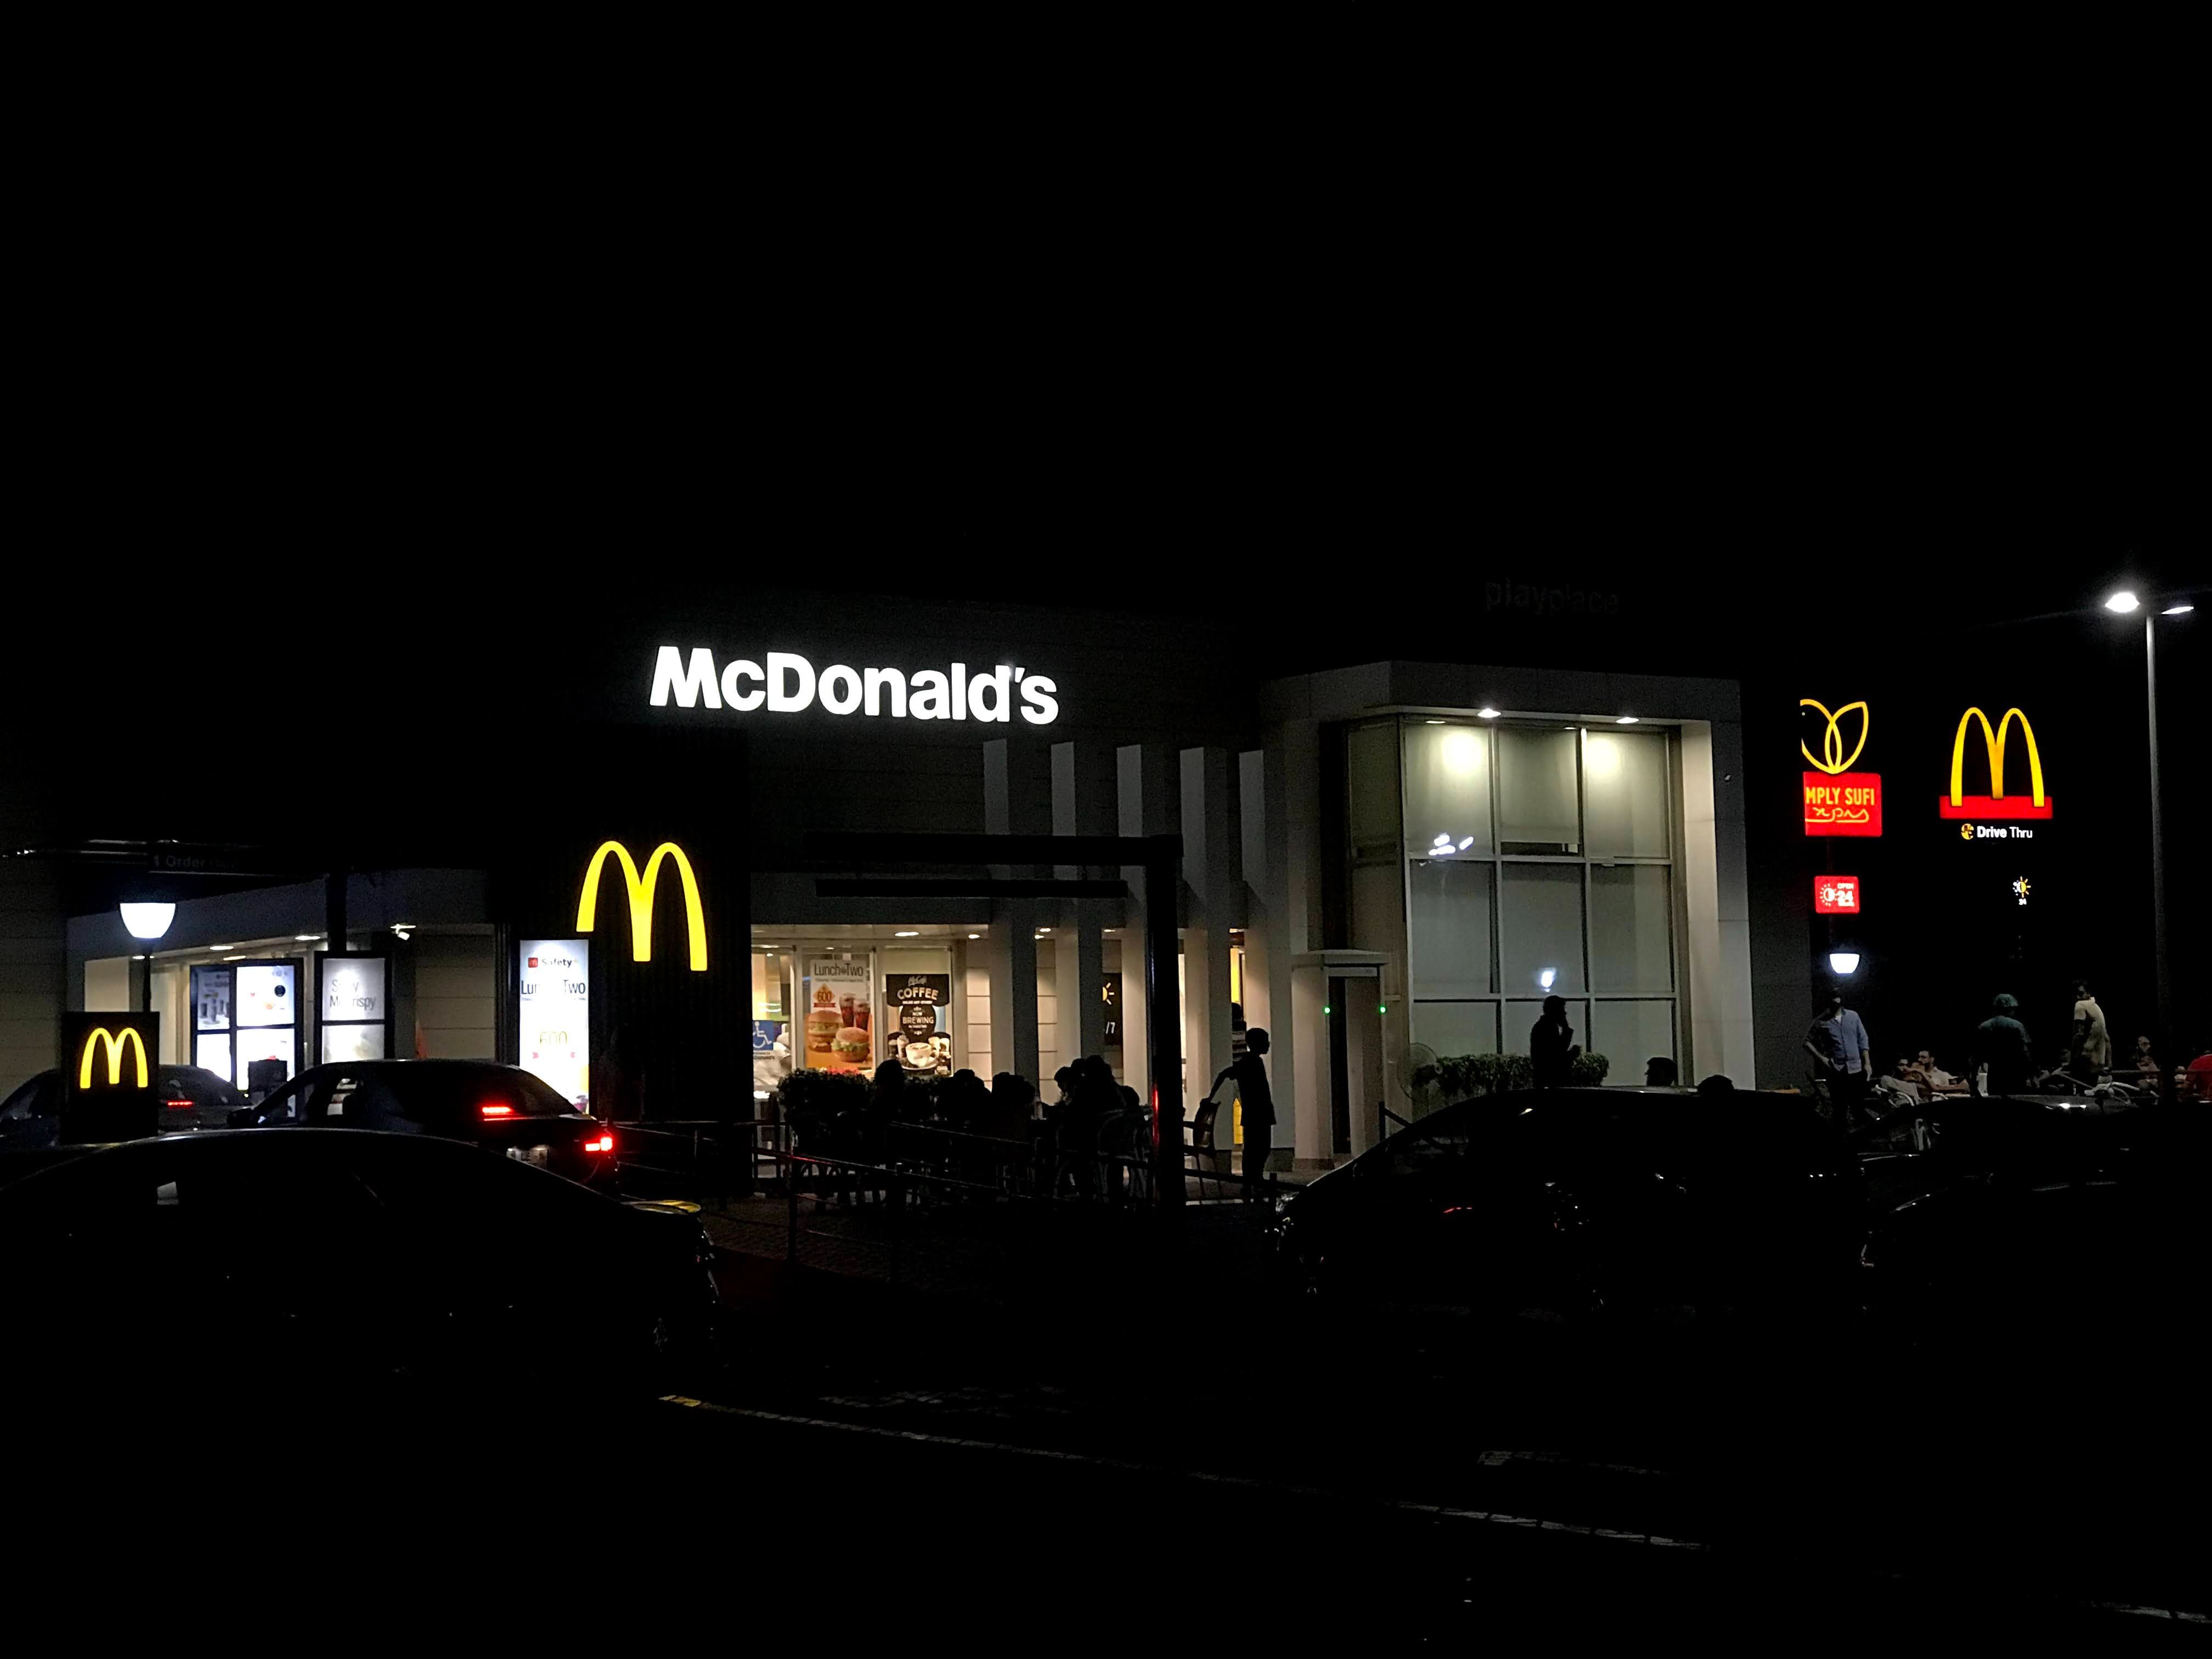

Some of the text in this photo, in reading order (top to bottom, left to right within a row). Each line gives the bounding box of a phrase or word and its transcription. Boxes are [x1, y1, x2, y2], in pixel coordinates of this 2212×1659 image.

[650, 646, 1059, 725] McDonald's
[1845, 787, 1875, 806] SUFI
[1977, 826, 2033, 838] Drive Thru
[1837, 890, 1854, 902] 24
[814, 963, 840, 975] Lunch
[845, 963, 864, 976] Two
[563, 980, 586, 994] Two
[897, 987, 939, 1000] COFFEE
[817, 991, 832, 1002] 600
